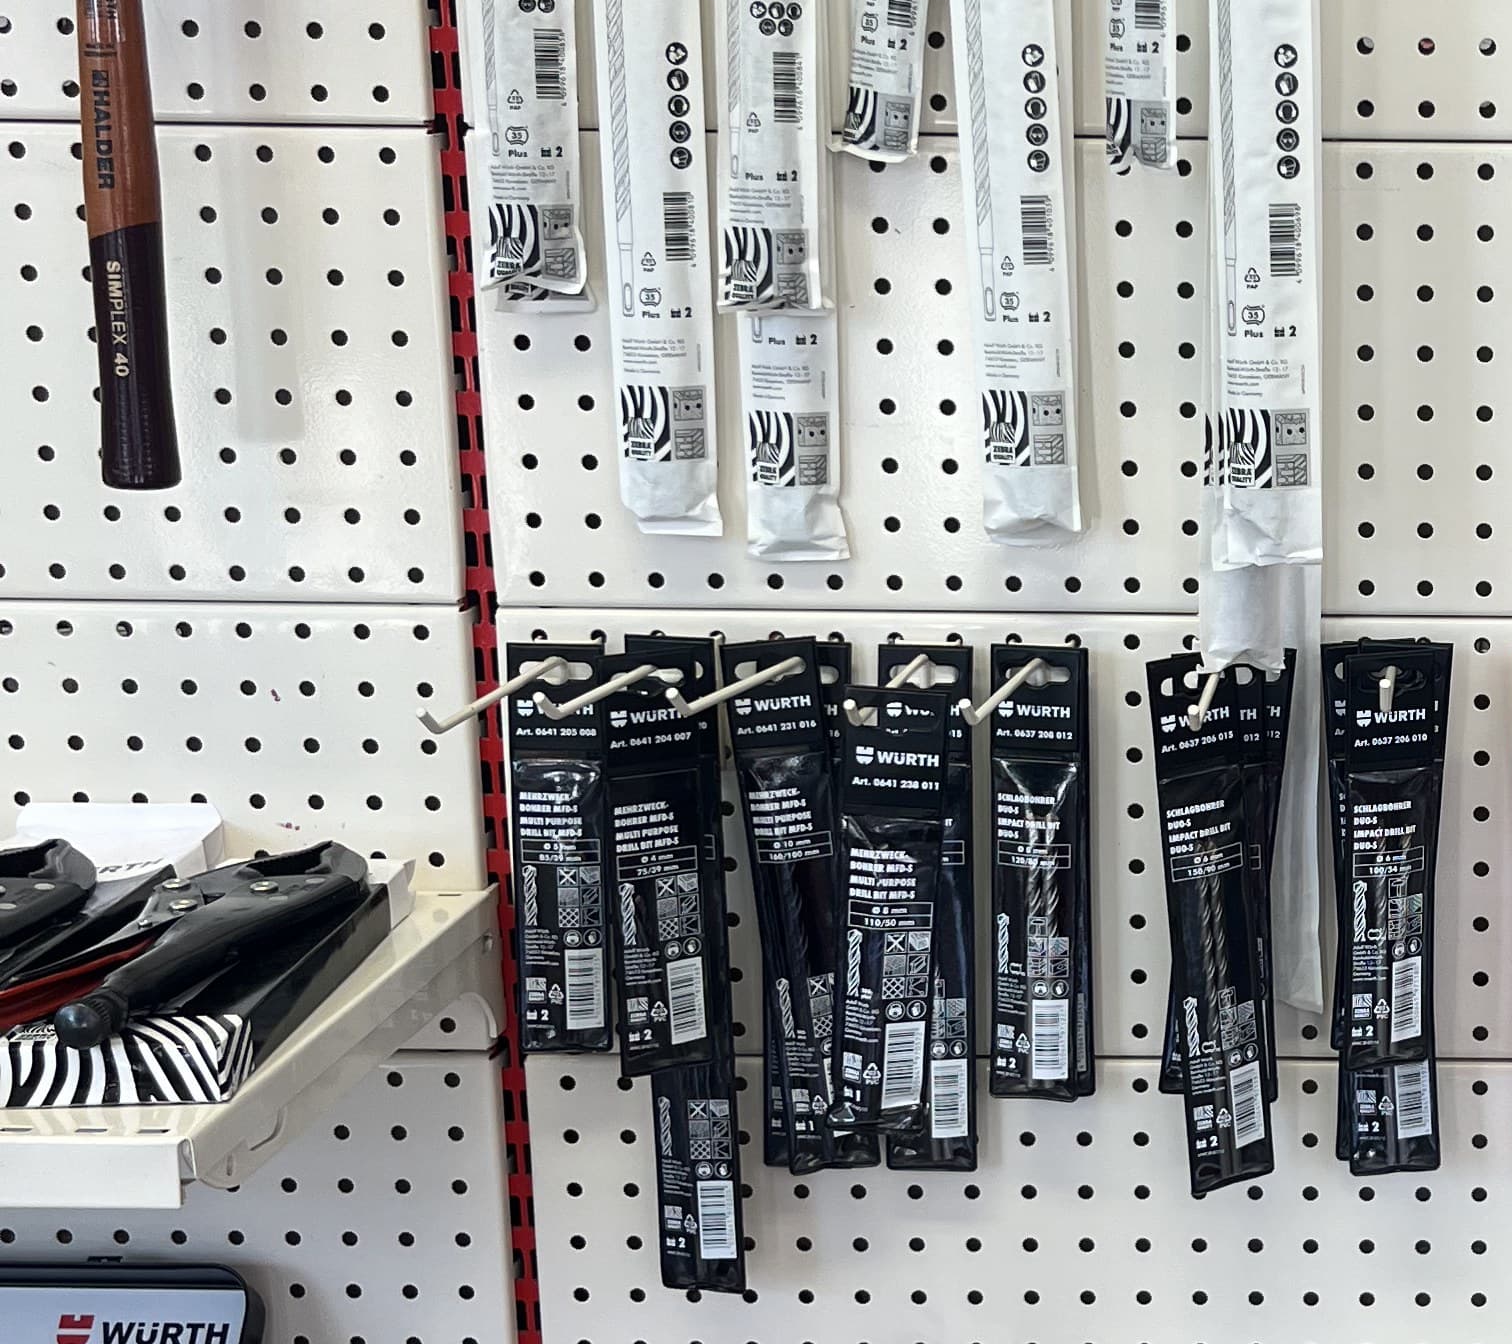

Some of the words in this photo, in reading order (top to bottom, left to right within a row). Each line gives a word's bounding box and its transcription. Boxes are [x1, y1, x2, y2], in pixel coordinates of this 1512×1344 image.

[92, 97, 114, 190] HALDER
[106, 259, 127, 346] SIMPLEX
[115, 351, 130, 377] 40
[754, 696, 811, 711] WÜRTH
[1016, 705, 1071, 718] WÜRTH
[1374, 708, 1426, 725] WÜRTH
[737, 726, 754, 736] Art.
[757, 723, 778, 734] 0641
[780, 721, 796, 732] 231
[799, 719, 816, 730] 016
[996, 728, 1011, 738] Art.
[1014, 730, 1035, 739] 0637
[1056, 731, 1073, 740] 012
[610, 739, 627, 750] Art.
[630, 736, 652, 748] 0641
[655, 734, 672, 745] 204
[674, 732, 692, 743] 007
[1354, 738, 1369, 746] Art.
[1372, 736, 1392, 746] 0637
[1394, 734, 1410, 744] 206
[1412, 733, 1428, 742] 010
[877, 752, 939, 768] WÜRTH
